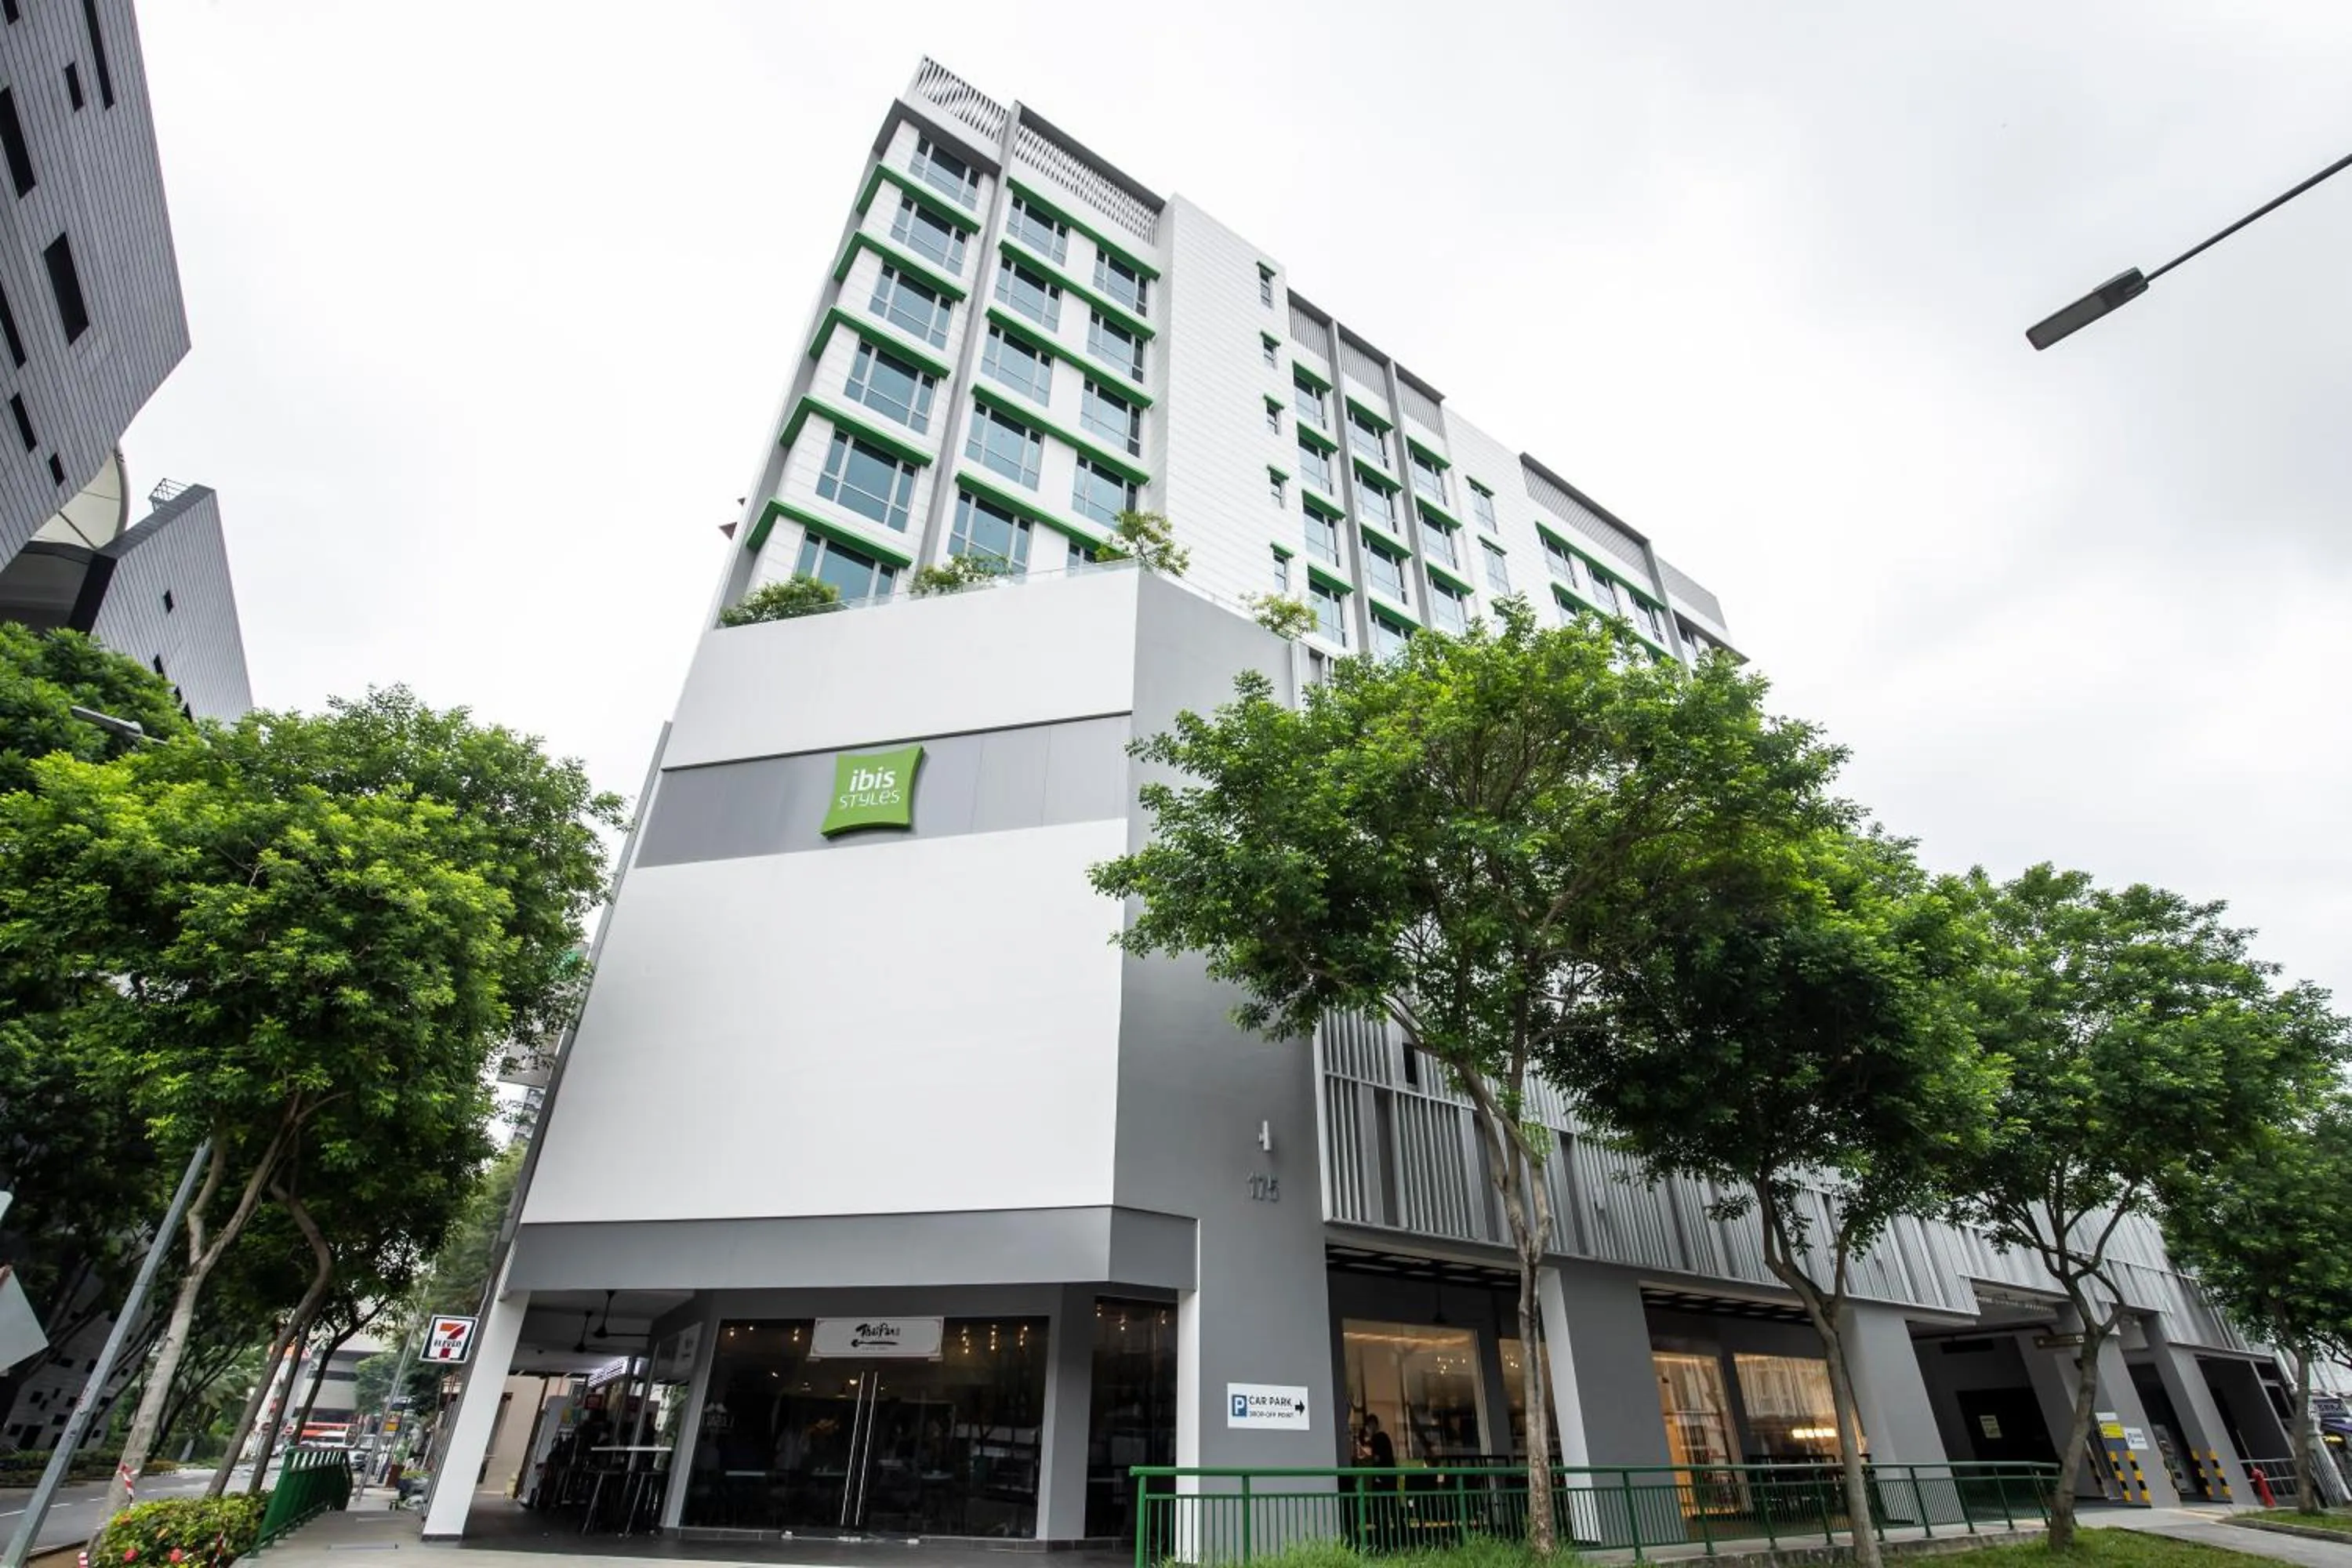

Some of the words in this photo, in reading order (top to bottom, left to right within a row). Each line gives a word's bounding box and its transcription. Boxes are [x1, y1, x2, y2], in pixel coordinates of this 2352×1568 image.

[849, 766, 896, 793] ibis
[1234, 1396, 1246, 1415] P
[1249, 1396, 1267, 1406] CAR
[1269, 1396, 1292, 1407] PARK
